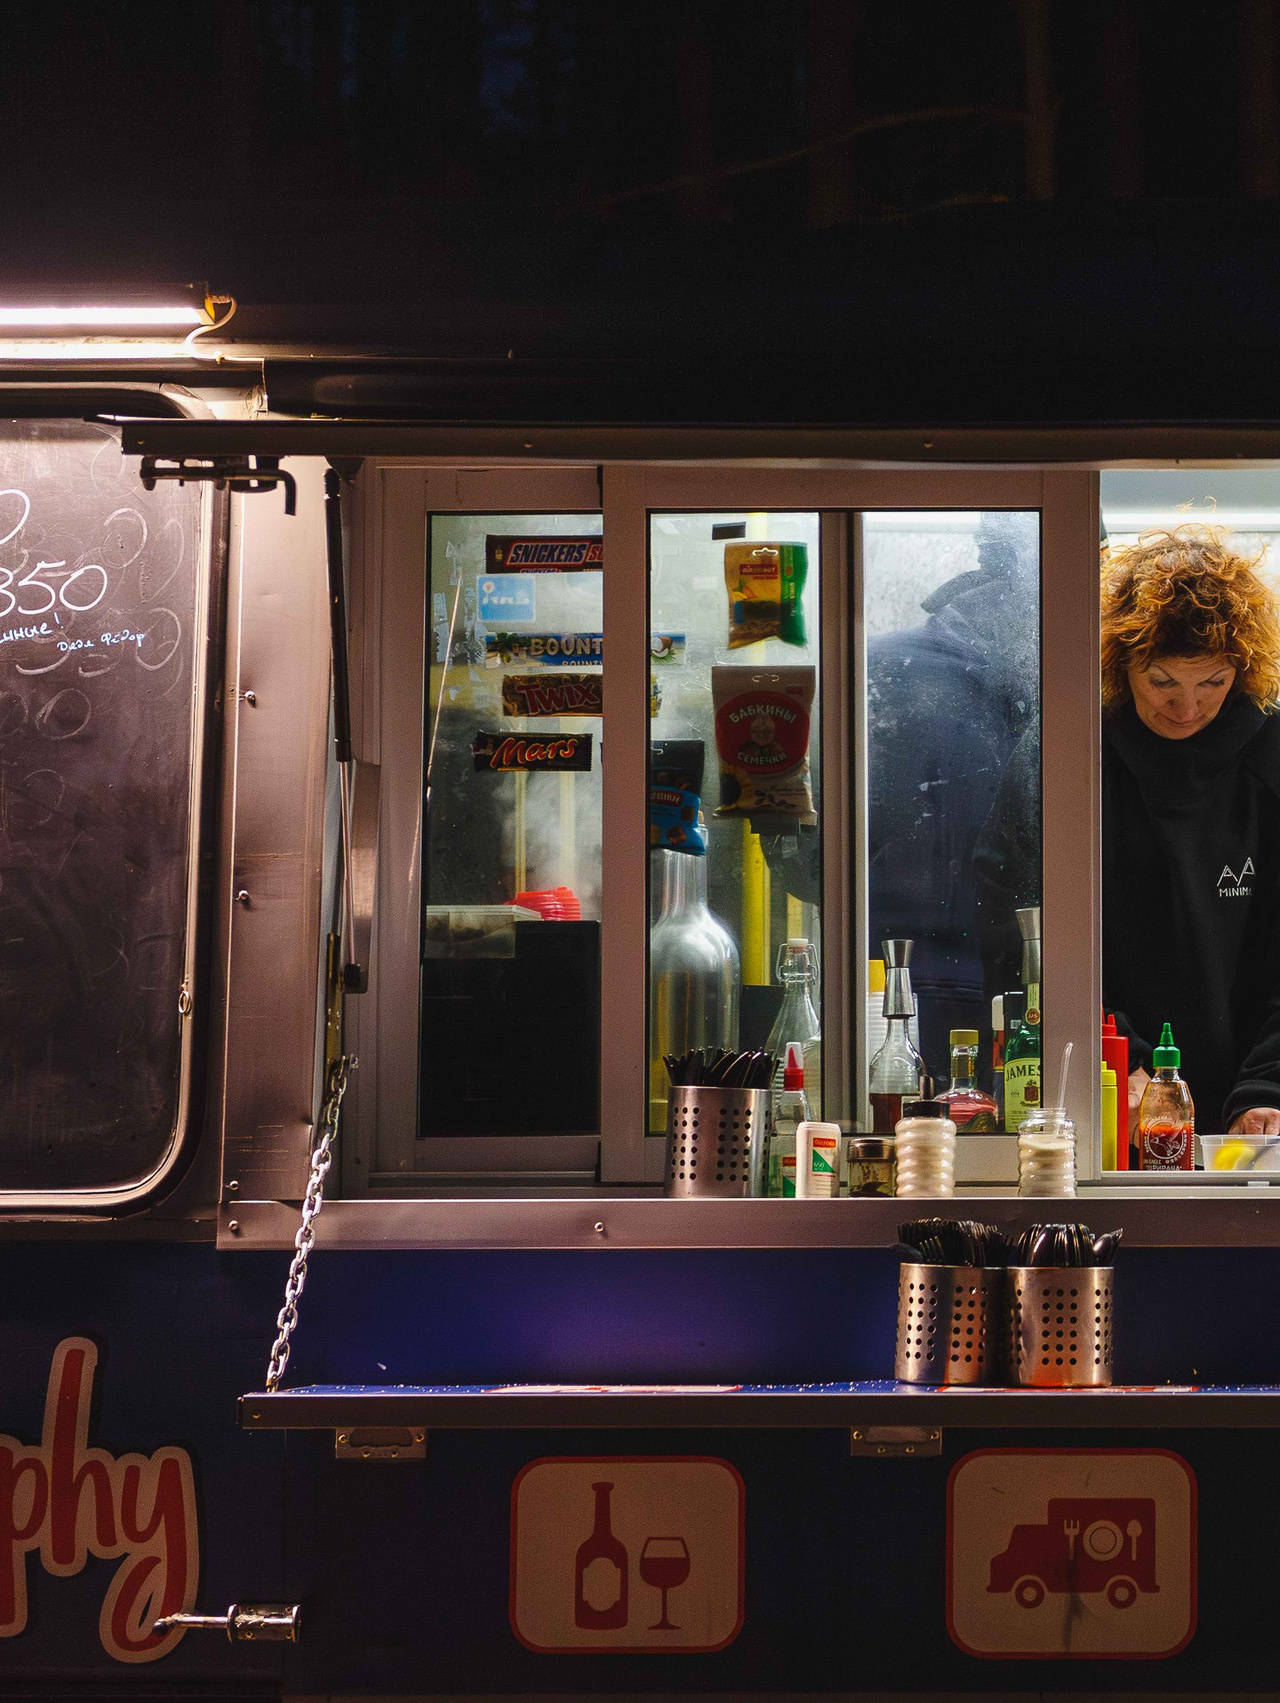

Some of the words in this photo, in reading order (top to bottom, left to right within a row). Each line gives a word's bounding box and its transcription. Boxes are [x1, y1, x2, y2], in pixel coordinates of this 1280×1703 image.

[509, 543, 589, 564] SNICKERS
[530, 637, 603, 656] BOUNT
[729, 704, 798, 723] БАБКИНЫ
[490, 737, 579, 769] Mars
[737, 751, 788, 765] СЕМЕЧКИ
[1006, 1064, 1040, 1082] JAMES
[0, 1348, 189, 1652] phy
